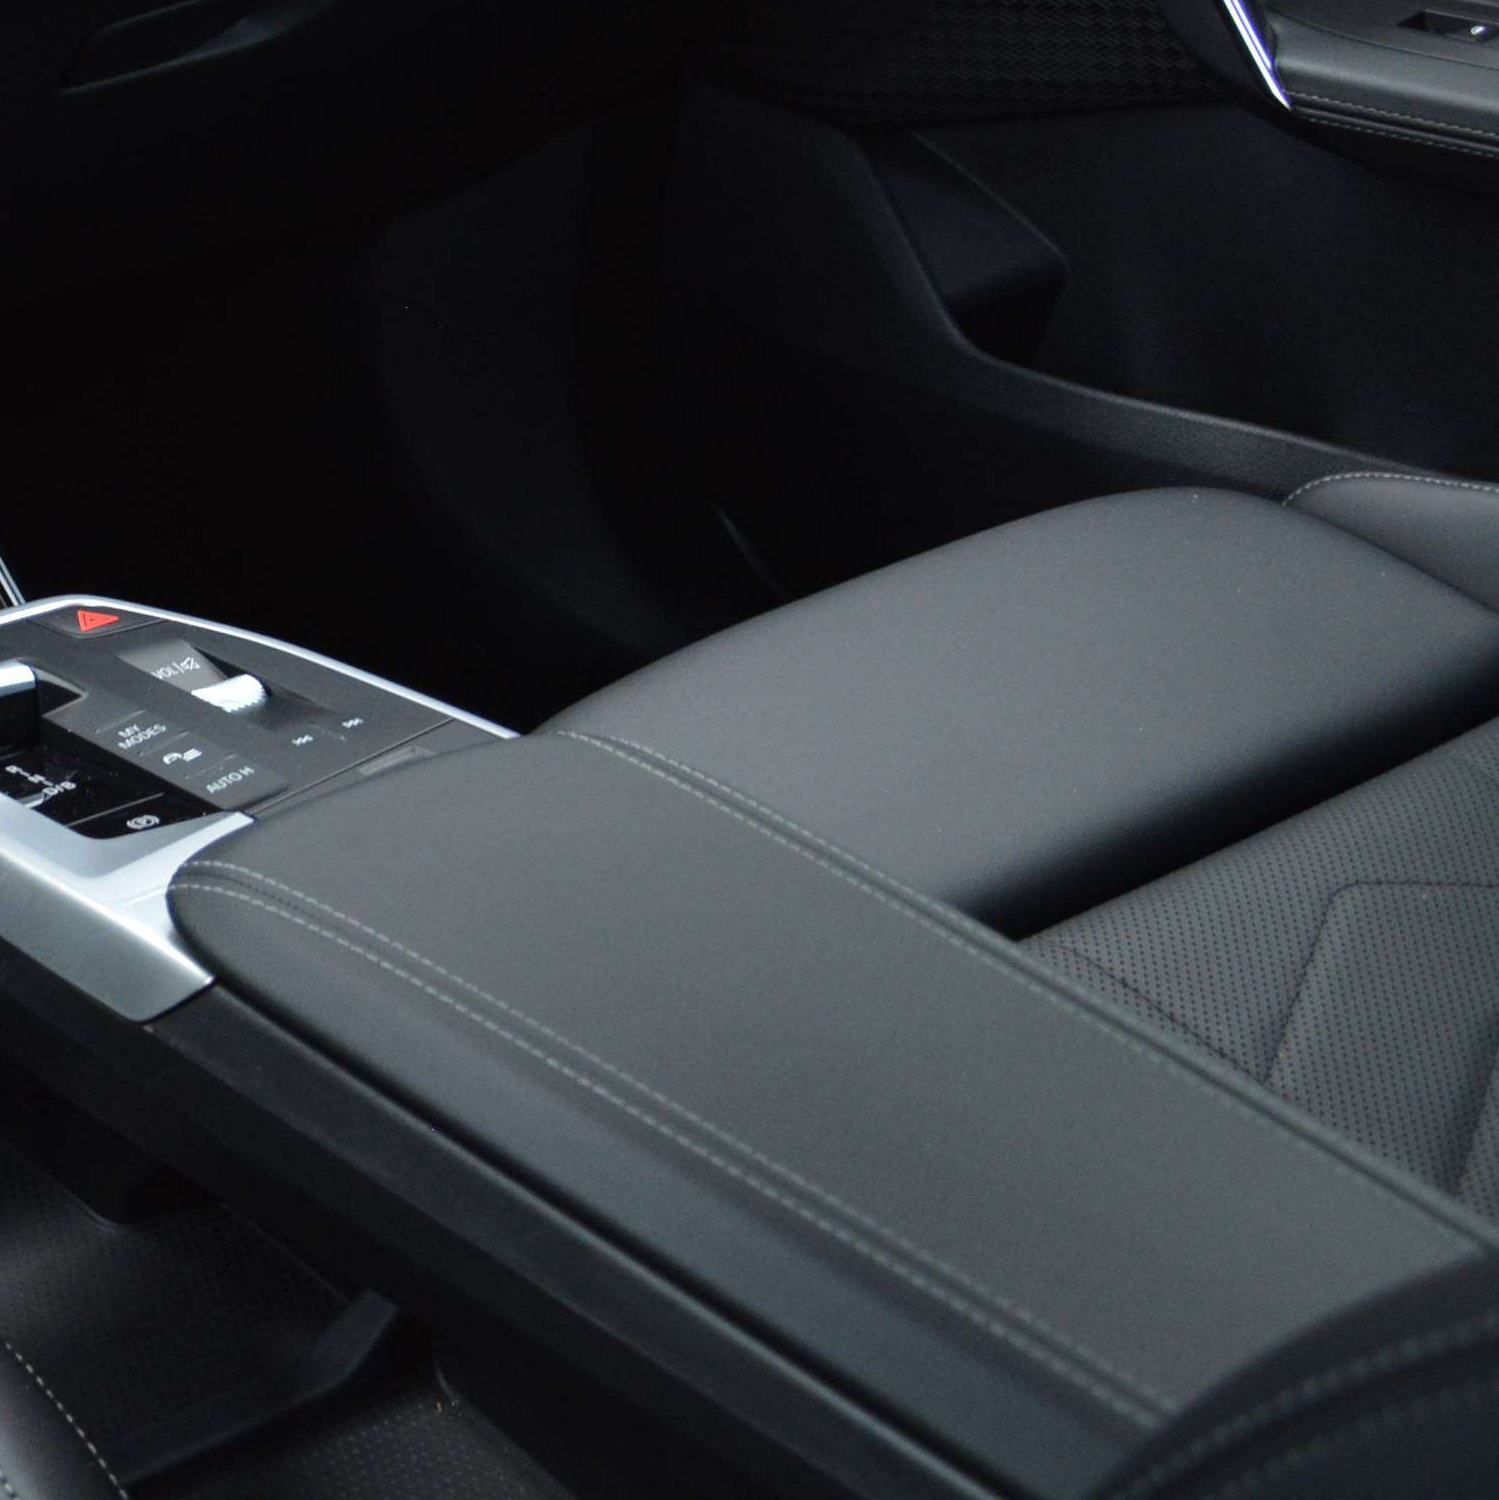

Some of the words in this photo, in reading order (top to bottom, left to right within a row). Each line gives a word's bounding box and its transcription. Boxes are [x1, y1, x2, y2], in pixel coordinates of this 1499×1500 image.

[118, 723, 140, 739] MY
[118, 724, 167, 750] MODES
[206, 771, 243, 794] AUTO
[240, 765, 256, 777] H
